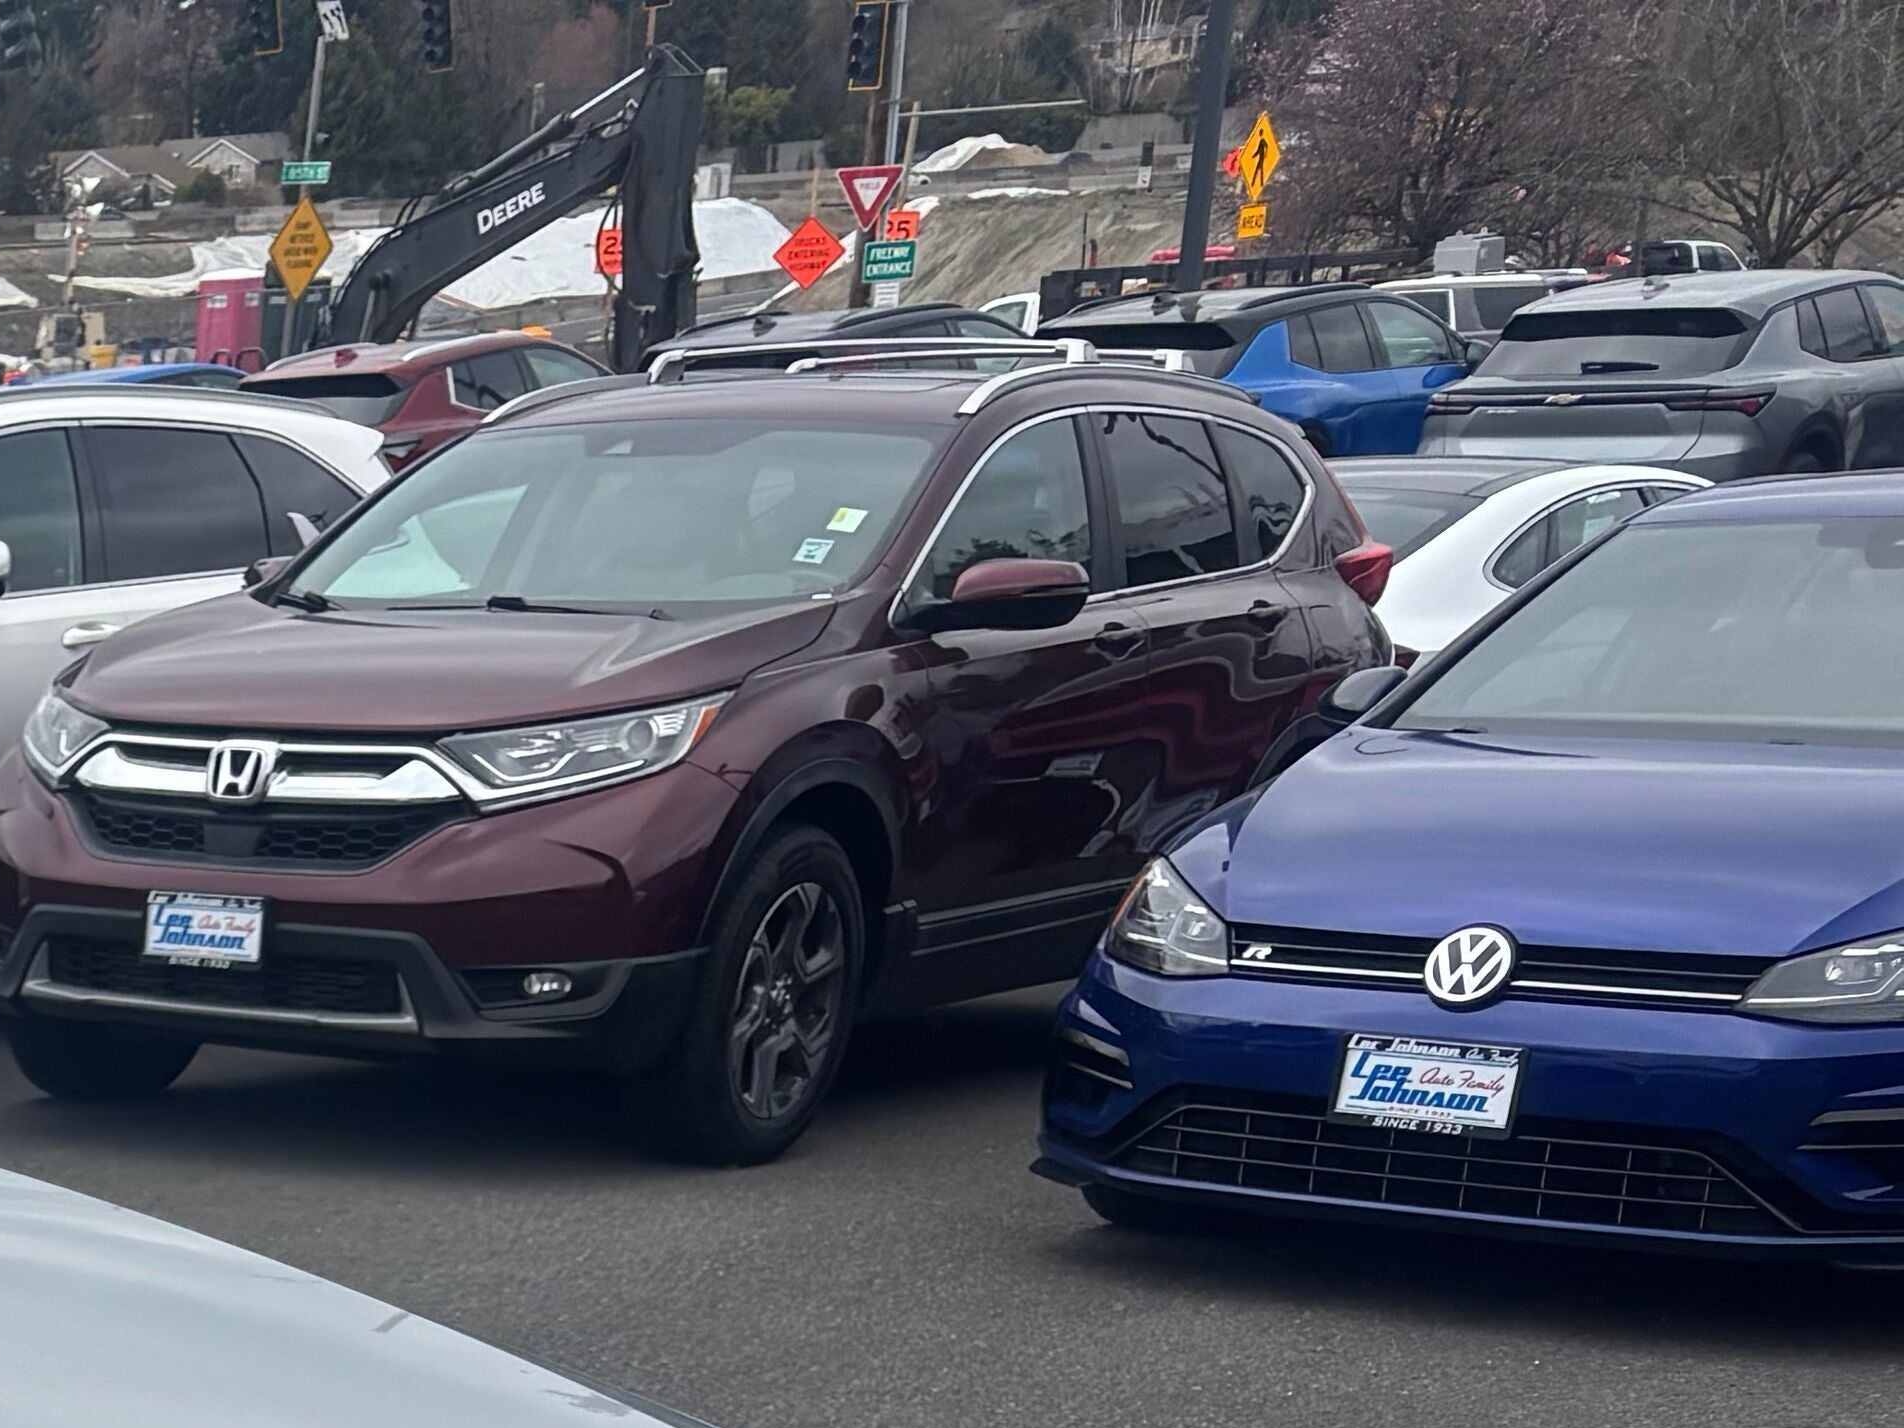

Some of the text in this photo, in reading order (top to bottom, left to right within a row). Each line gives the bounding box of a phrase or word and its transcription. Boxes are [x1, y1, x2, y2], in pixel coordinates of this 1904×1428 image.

[476, 181, 546, 235] DEERE
[794, 237, 827, 247] TRUCKS
[787, 248, 830, 261] ENTERING
[869, 246, 912, 262] FREEWAY
[788, 260, 827, 271] HIGHWAY
[865, 260, 913, 278] ENTRANCE
[153, 903, 194, 927] Lee
[153, 926, 246, 950] Johnson
[1386, 1036, 1461, 1057] Johnson
[1350, 1050, 1413, 1082] Lee
[1419, 1066, 1505, 1098] Auto Family
[1349, 1076, 1489, 1113] Johnson
[1372, 1116, 1464, 1136] SINCE 1933
